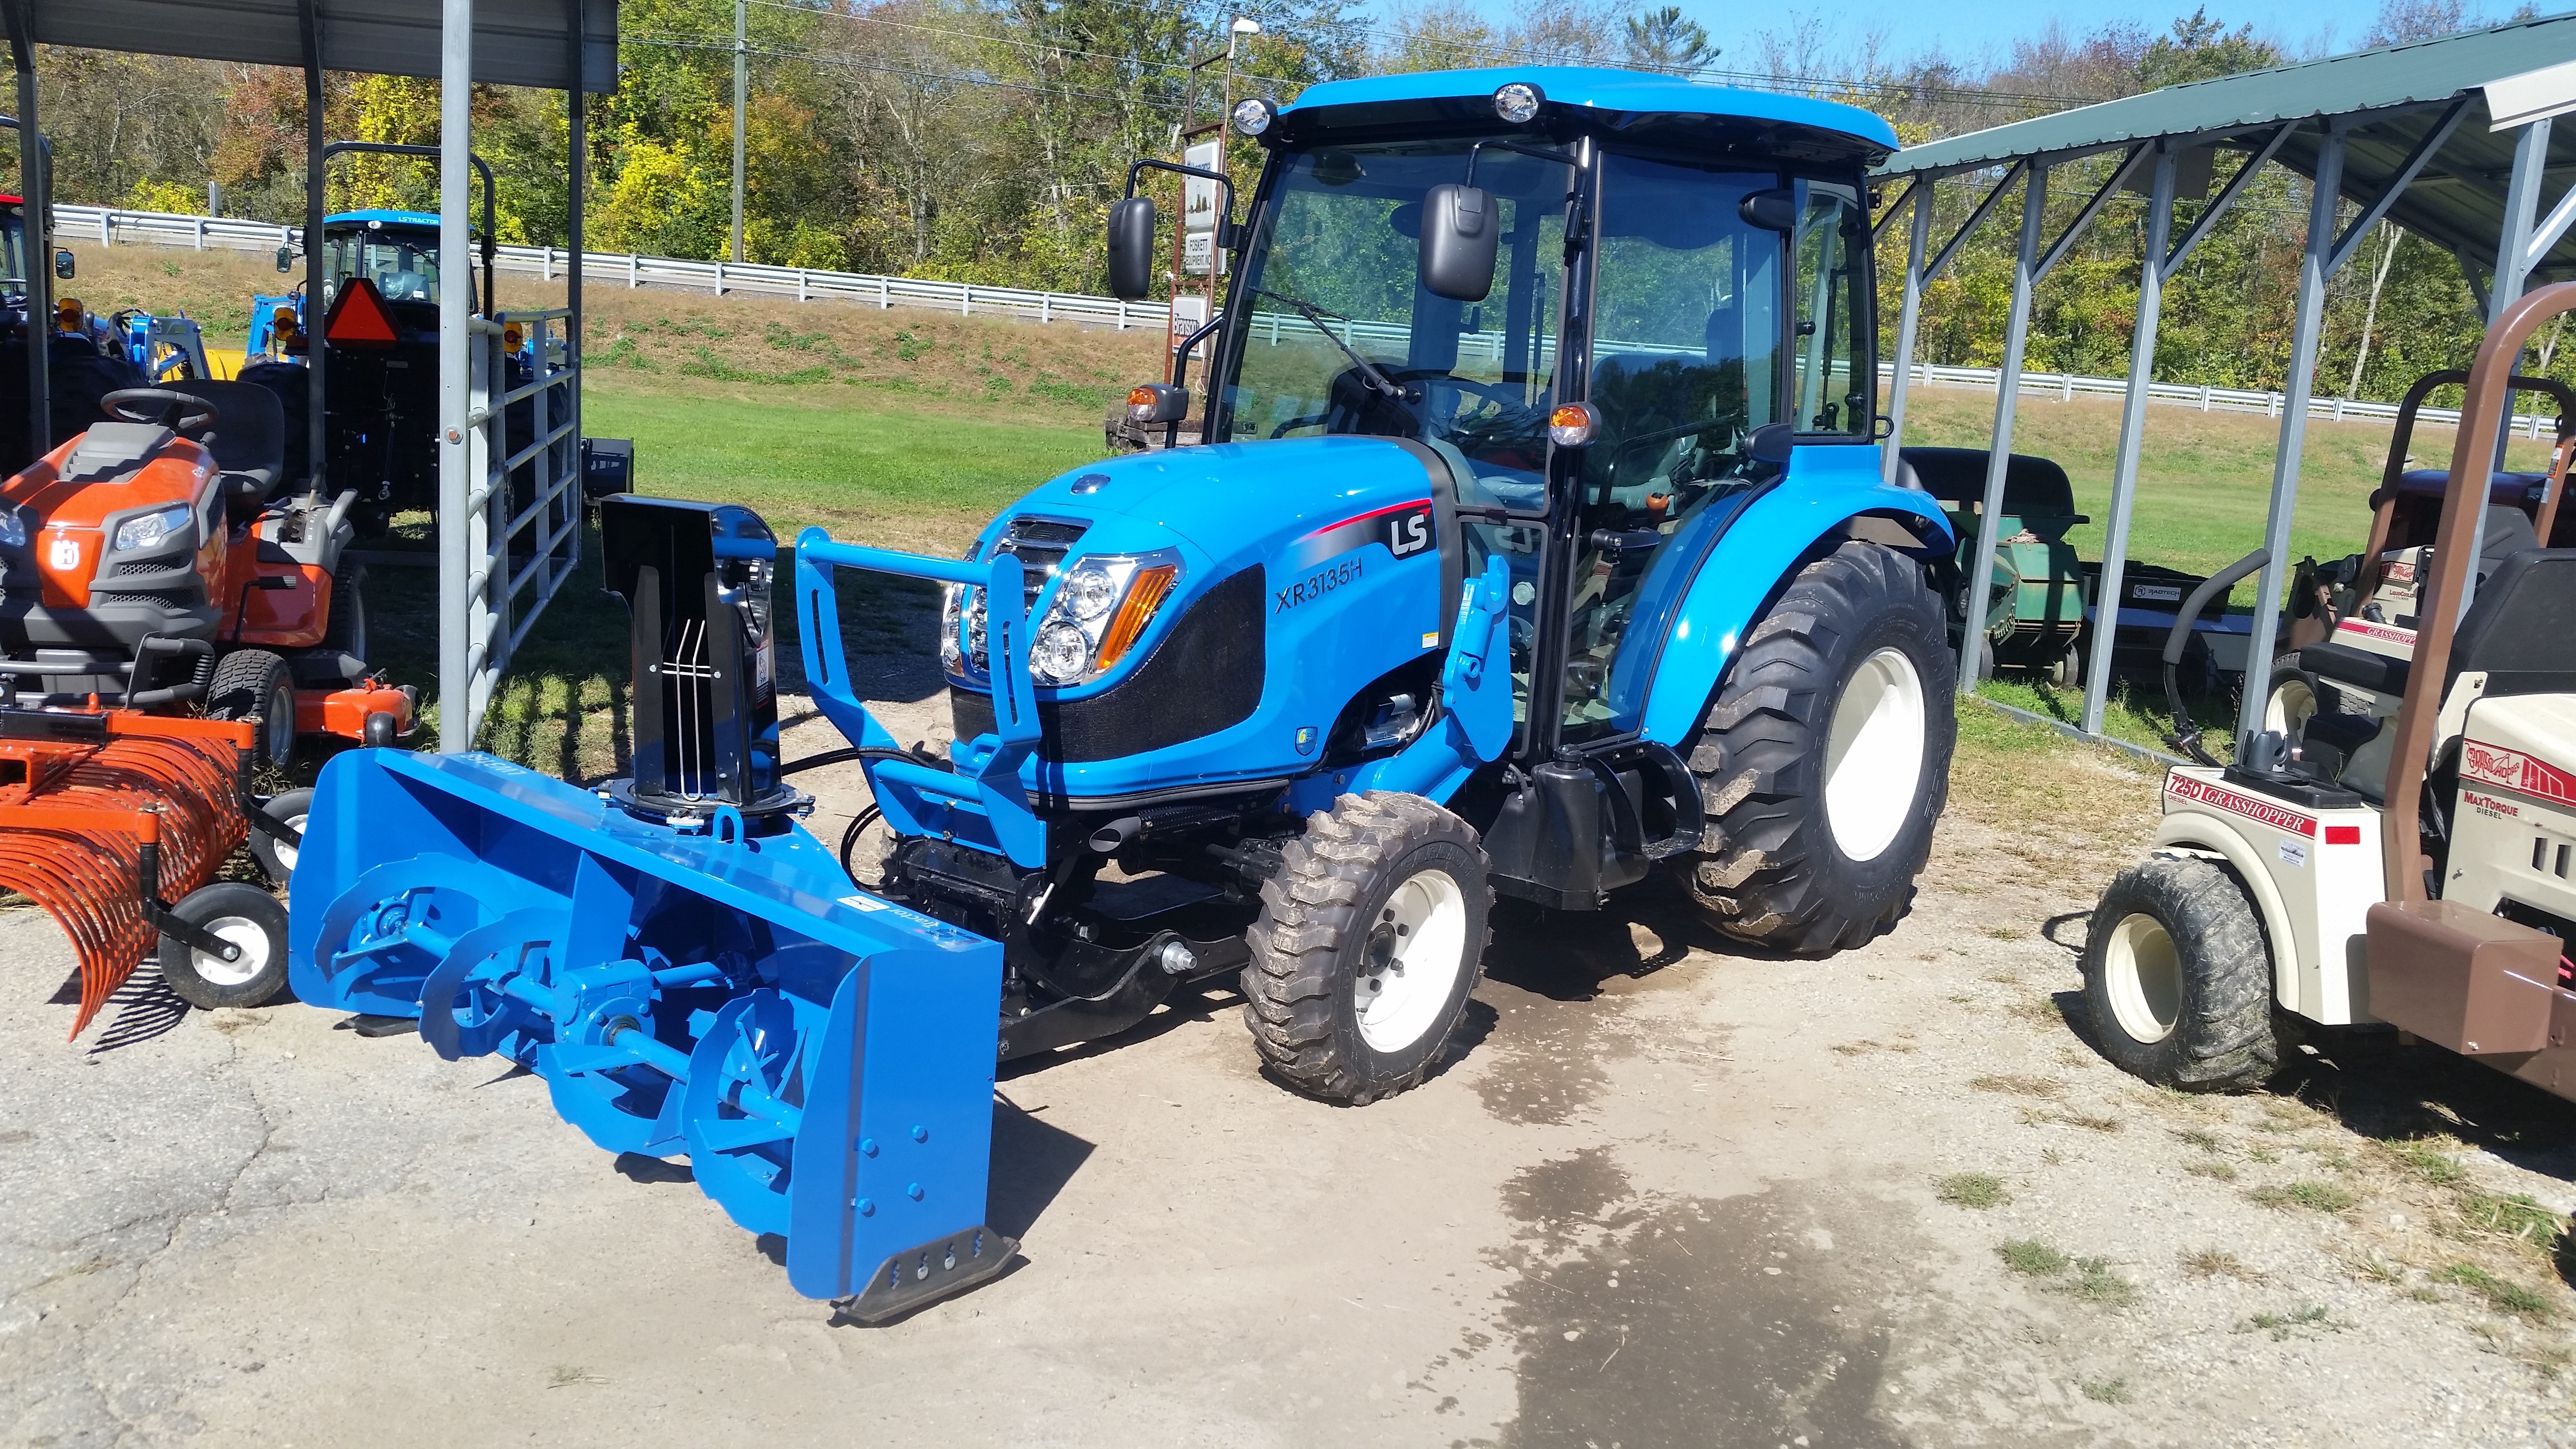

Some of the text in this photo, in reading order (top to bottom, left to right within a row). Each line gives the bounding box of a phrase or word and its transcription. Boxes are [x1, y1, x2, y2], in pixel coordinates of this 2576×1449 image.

[1190, 239, 1208, 251] FOSKETT
[1174, 313, 1198, 337] Branson
[1391, 514, 1427, 555] LS
[1274, 556, 1362, 614] XR3135H
[2148, 589, 2180, 597] RADTECH
[2367, 628, 2416, 644] GRASSHOPP
[2466, 747, 2520, 779] GRASSHOPPER
[2168, 794, 2188, 805] DIESEL
[2169, 776, 2305, 831] 725D GRASSHOPPER
[2477, 807, 2502, 820] DIESEL
[887, 909, 939, 929] Tractor
